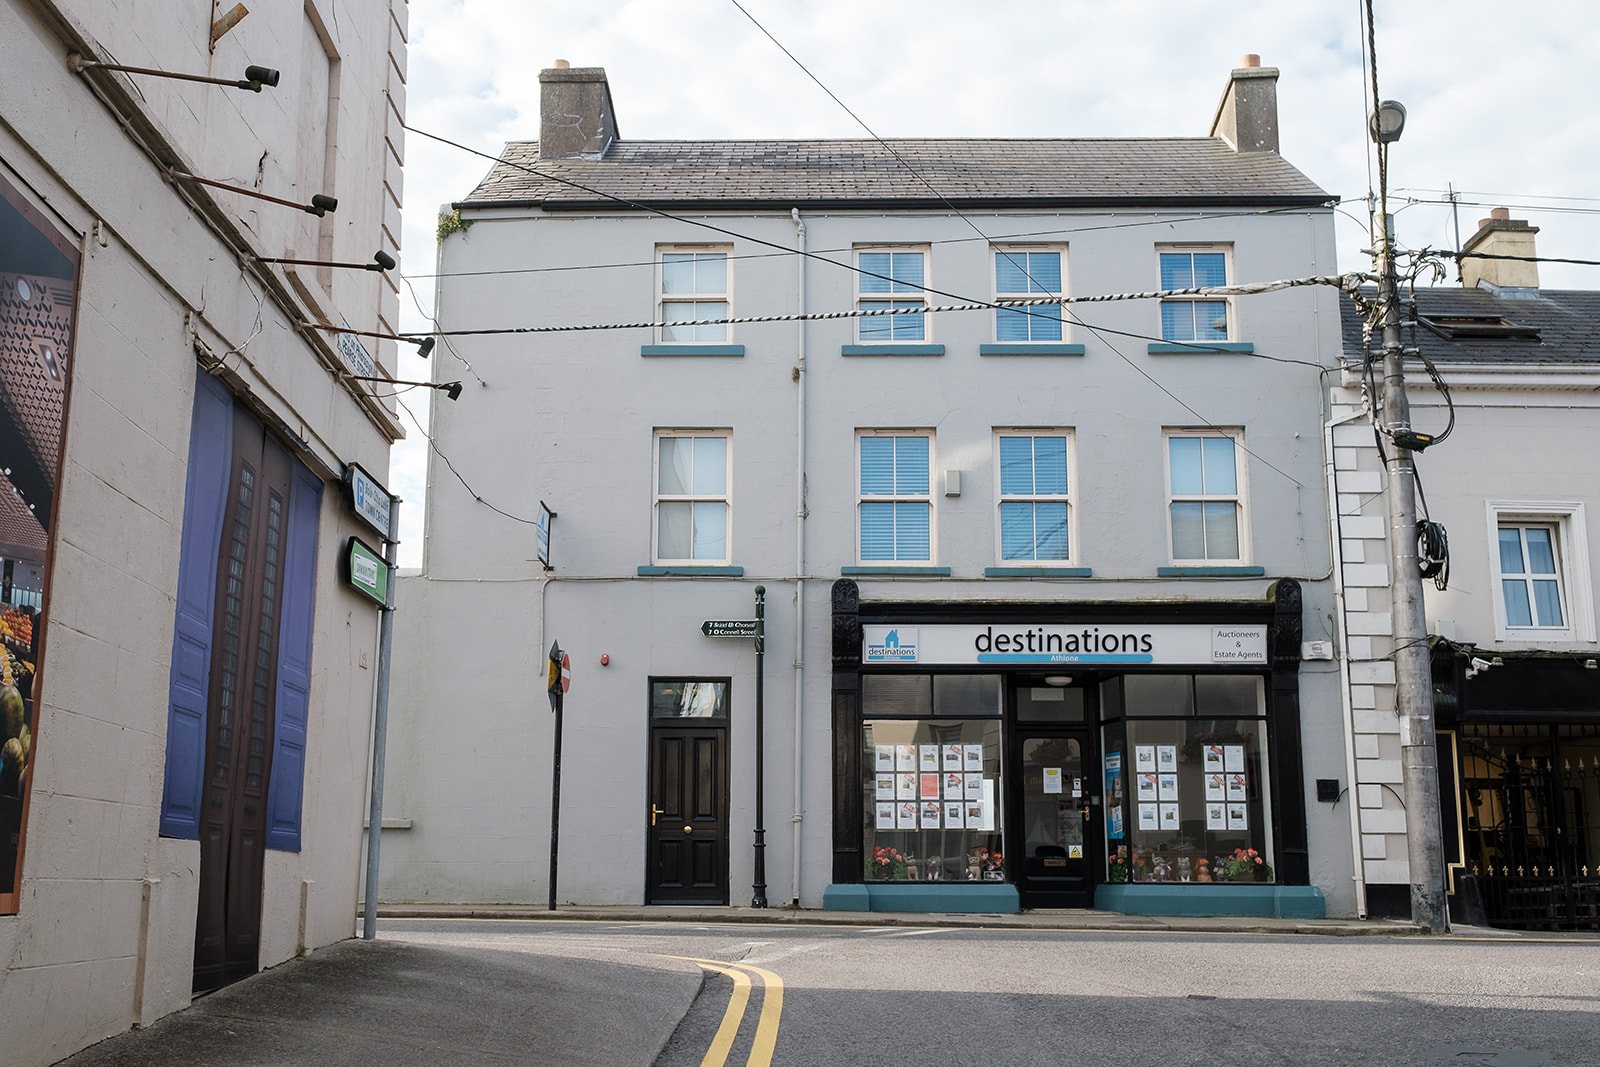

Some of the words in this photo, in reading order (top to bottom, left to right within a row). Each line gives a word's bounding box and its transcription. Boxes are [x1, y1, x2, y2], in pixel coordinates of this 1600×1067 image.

[1217, 630, 1260, 639] Auctioneers
[975, 626, 1153, 653] destinations
[868, 648, 916, 656] destinations
[1237, 651, 1263, 660] Agents
[1050, 654, 1079, 662] Athlone
